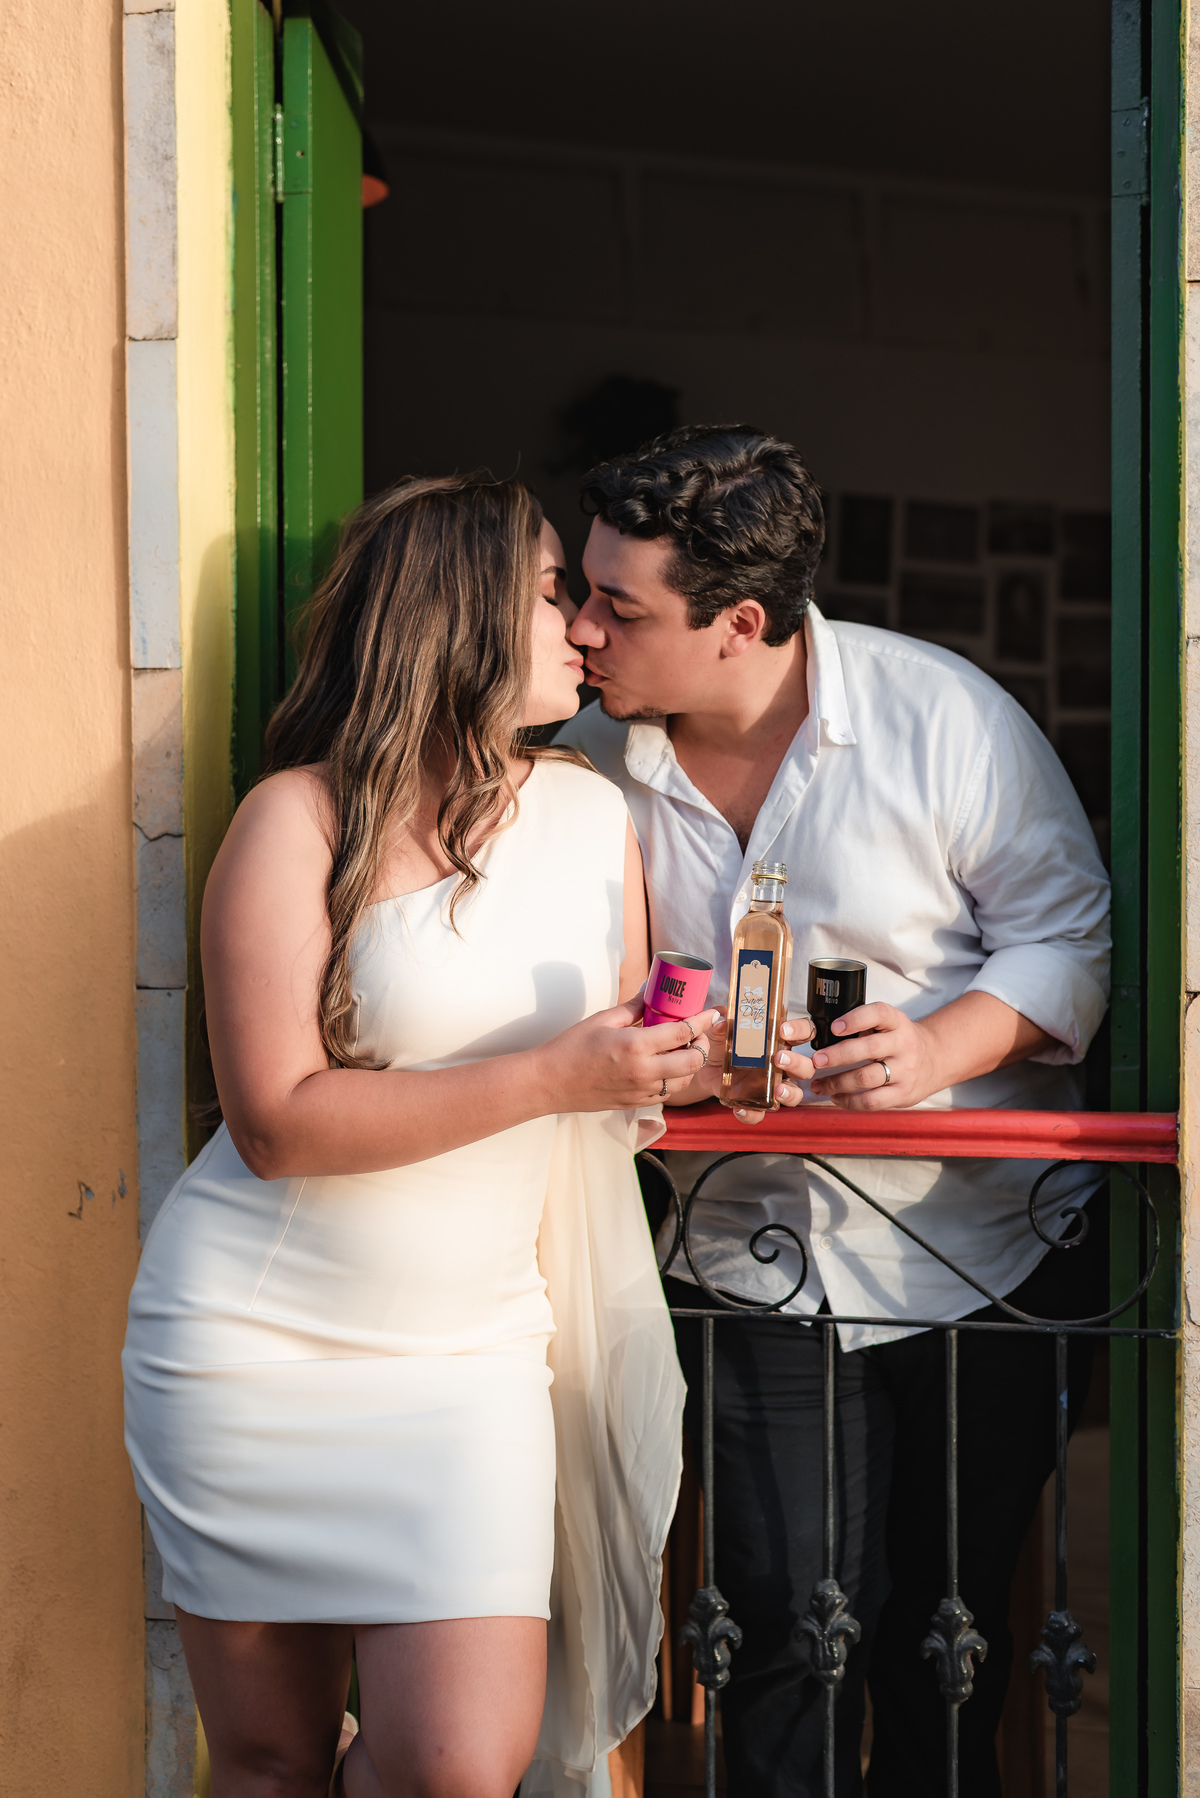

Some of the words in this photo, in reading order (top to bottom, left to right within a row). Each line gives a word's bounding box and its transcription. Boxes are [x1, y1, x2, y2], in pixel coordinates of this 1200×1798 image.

[660, 974, 687, 998] LOUIZE
[743, 986, 764, 997] 14
[816, 977, 840, 998] PIETRO
[740, 991, 764, 1004] Save
[739, 1018, 764, 1030] 26
